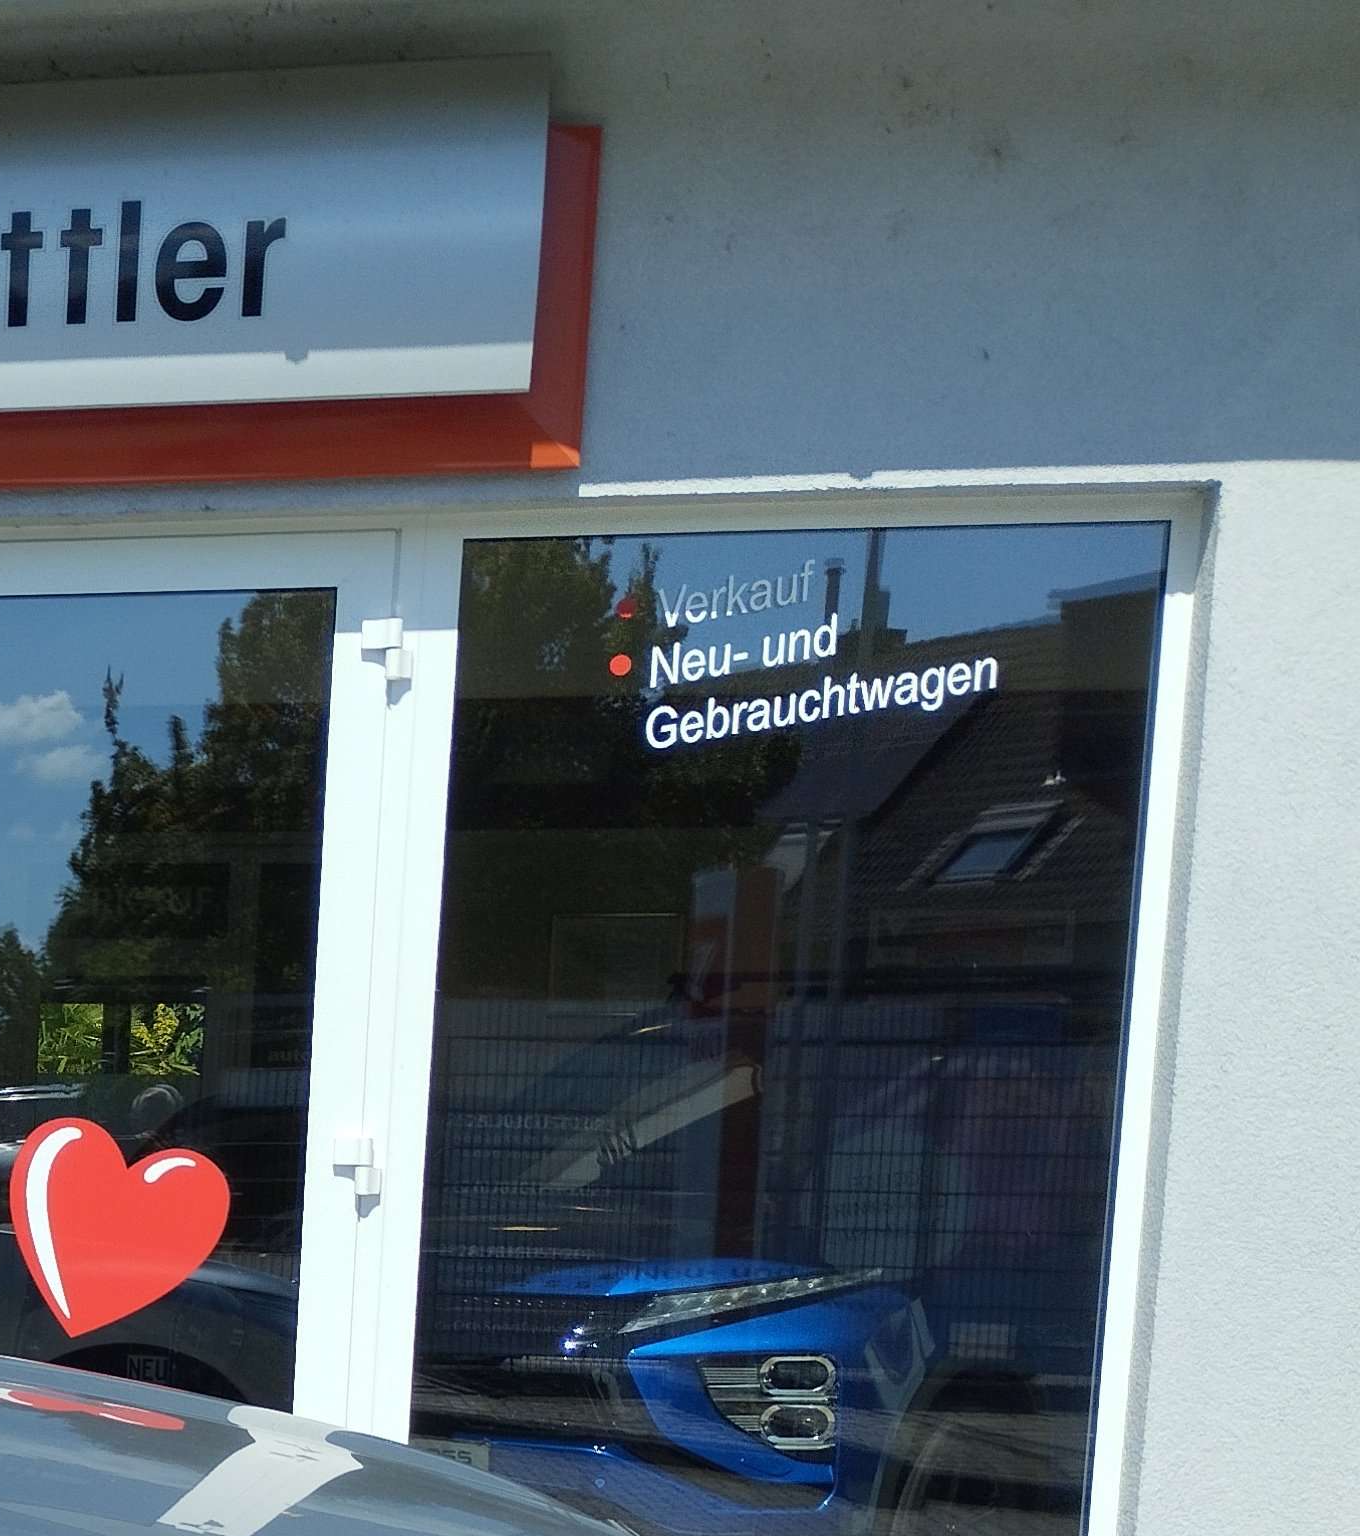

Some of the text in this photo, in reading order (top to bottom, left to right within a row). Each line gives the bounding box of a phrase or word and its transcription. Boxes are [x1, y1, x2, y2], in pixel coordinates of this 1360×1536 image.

[657, 558, 816, 629] Verkauf
[647, 613, 839, 690] Neu- und
[644, 656, 999, 751] Gebrauchtwagen
